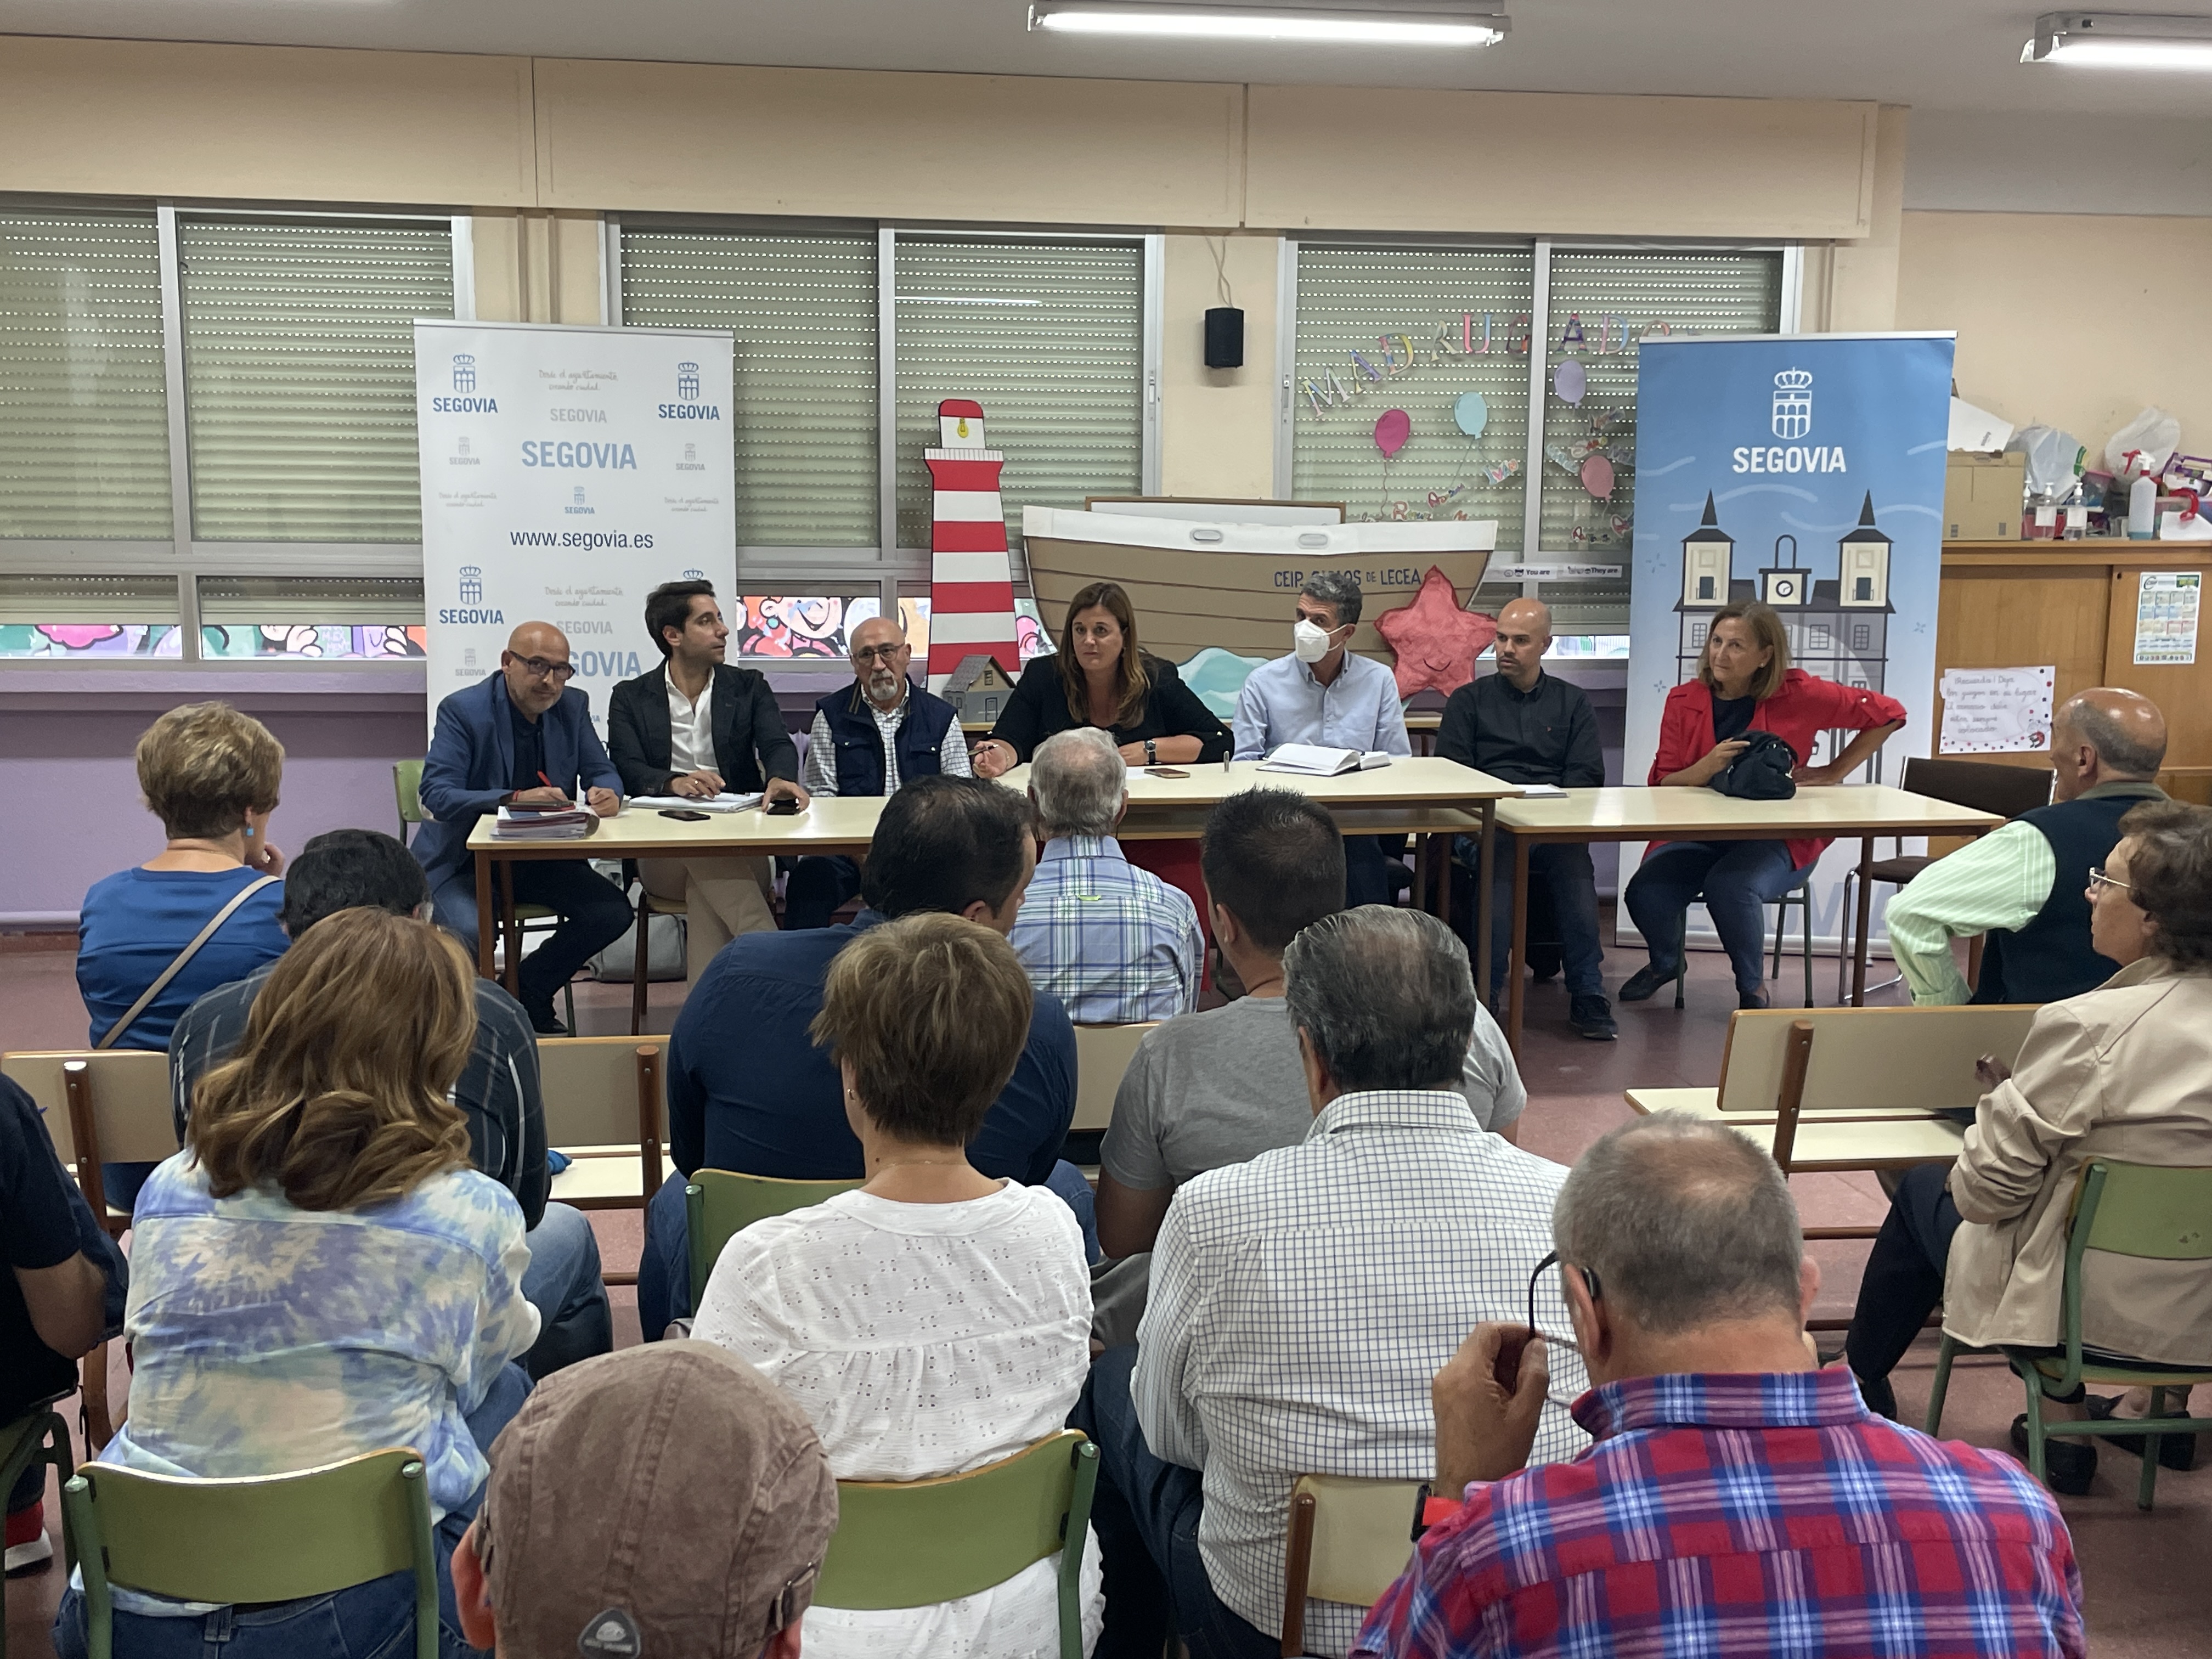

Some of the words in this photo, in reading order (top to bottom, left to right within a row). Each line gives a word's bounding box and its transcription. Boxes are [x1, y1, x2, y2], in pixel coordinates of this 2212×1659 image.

[433, 397, 498, 414] SEGOVIA
[658, 404, 720, 420] SEGOVIA
[550, 408, 607, 424] SEGOVIA
[449, 457, 481, 466] SEGOVIA
[522, 441, 637, 470] SEGOVIA
[1732, 447, 1846, 473] SEGOVIA
[510, 529, 653, 551] www.segovia.es
[1380, 568, 1421, 585] LECEA
[439, 609, 504, 624] SEGOVIA
[568, 651, 642, 677] GOVIA
